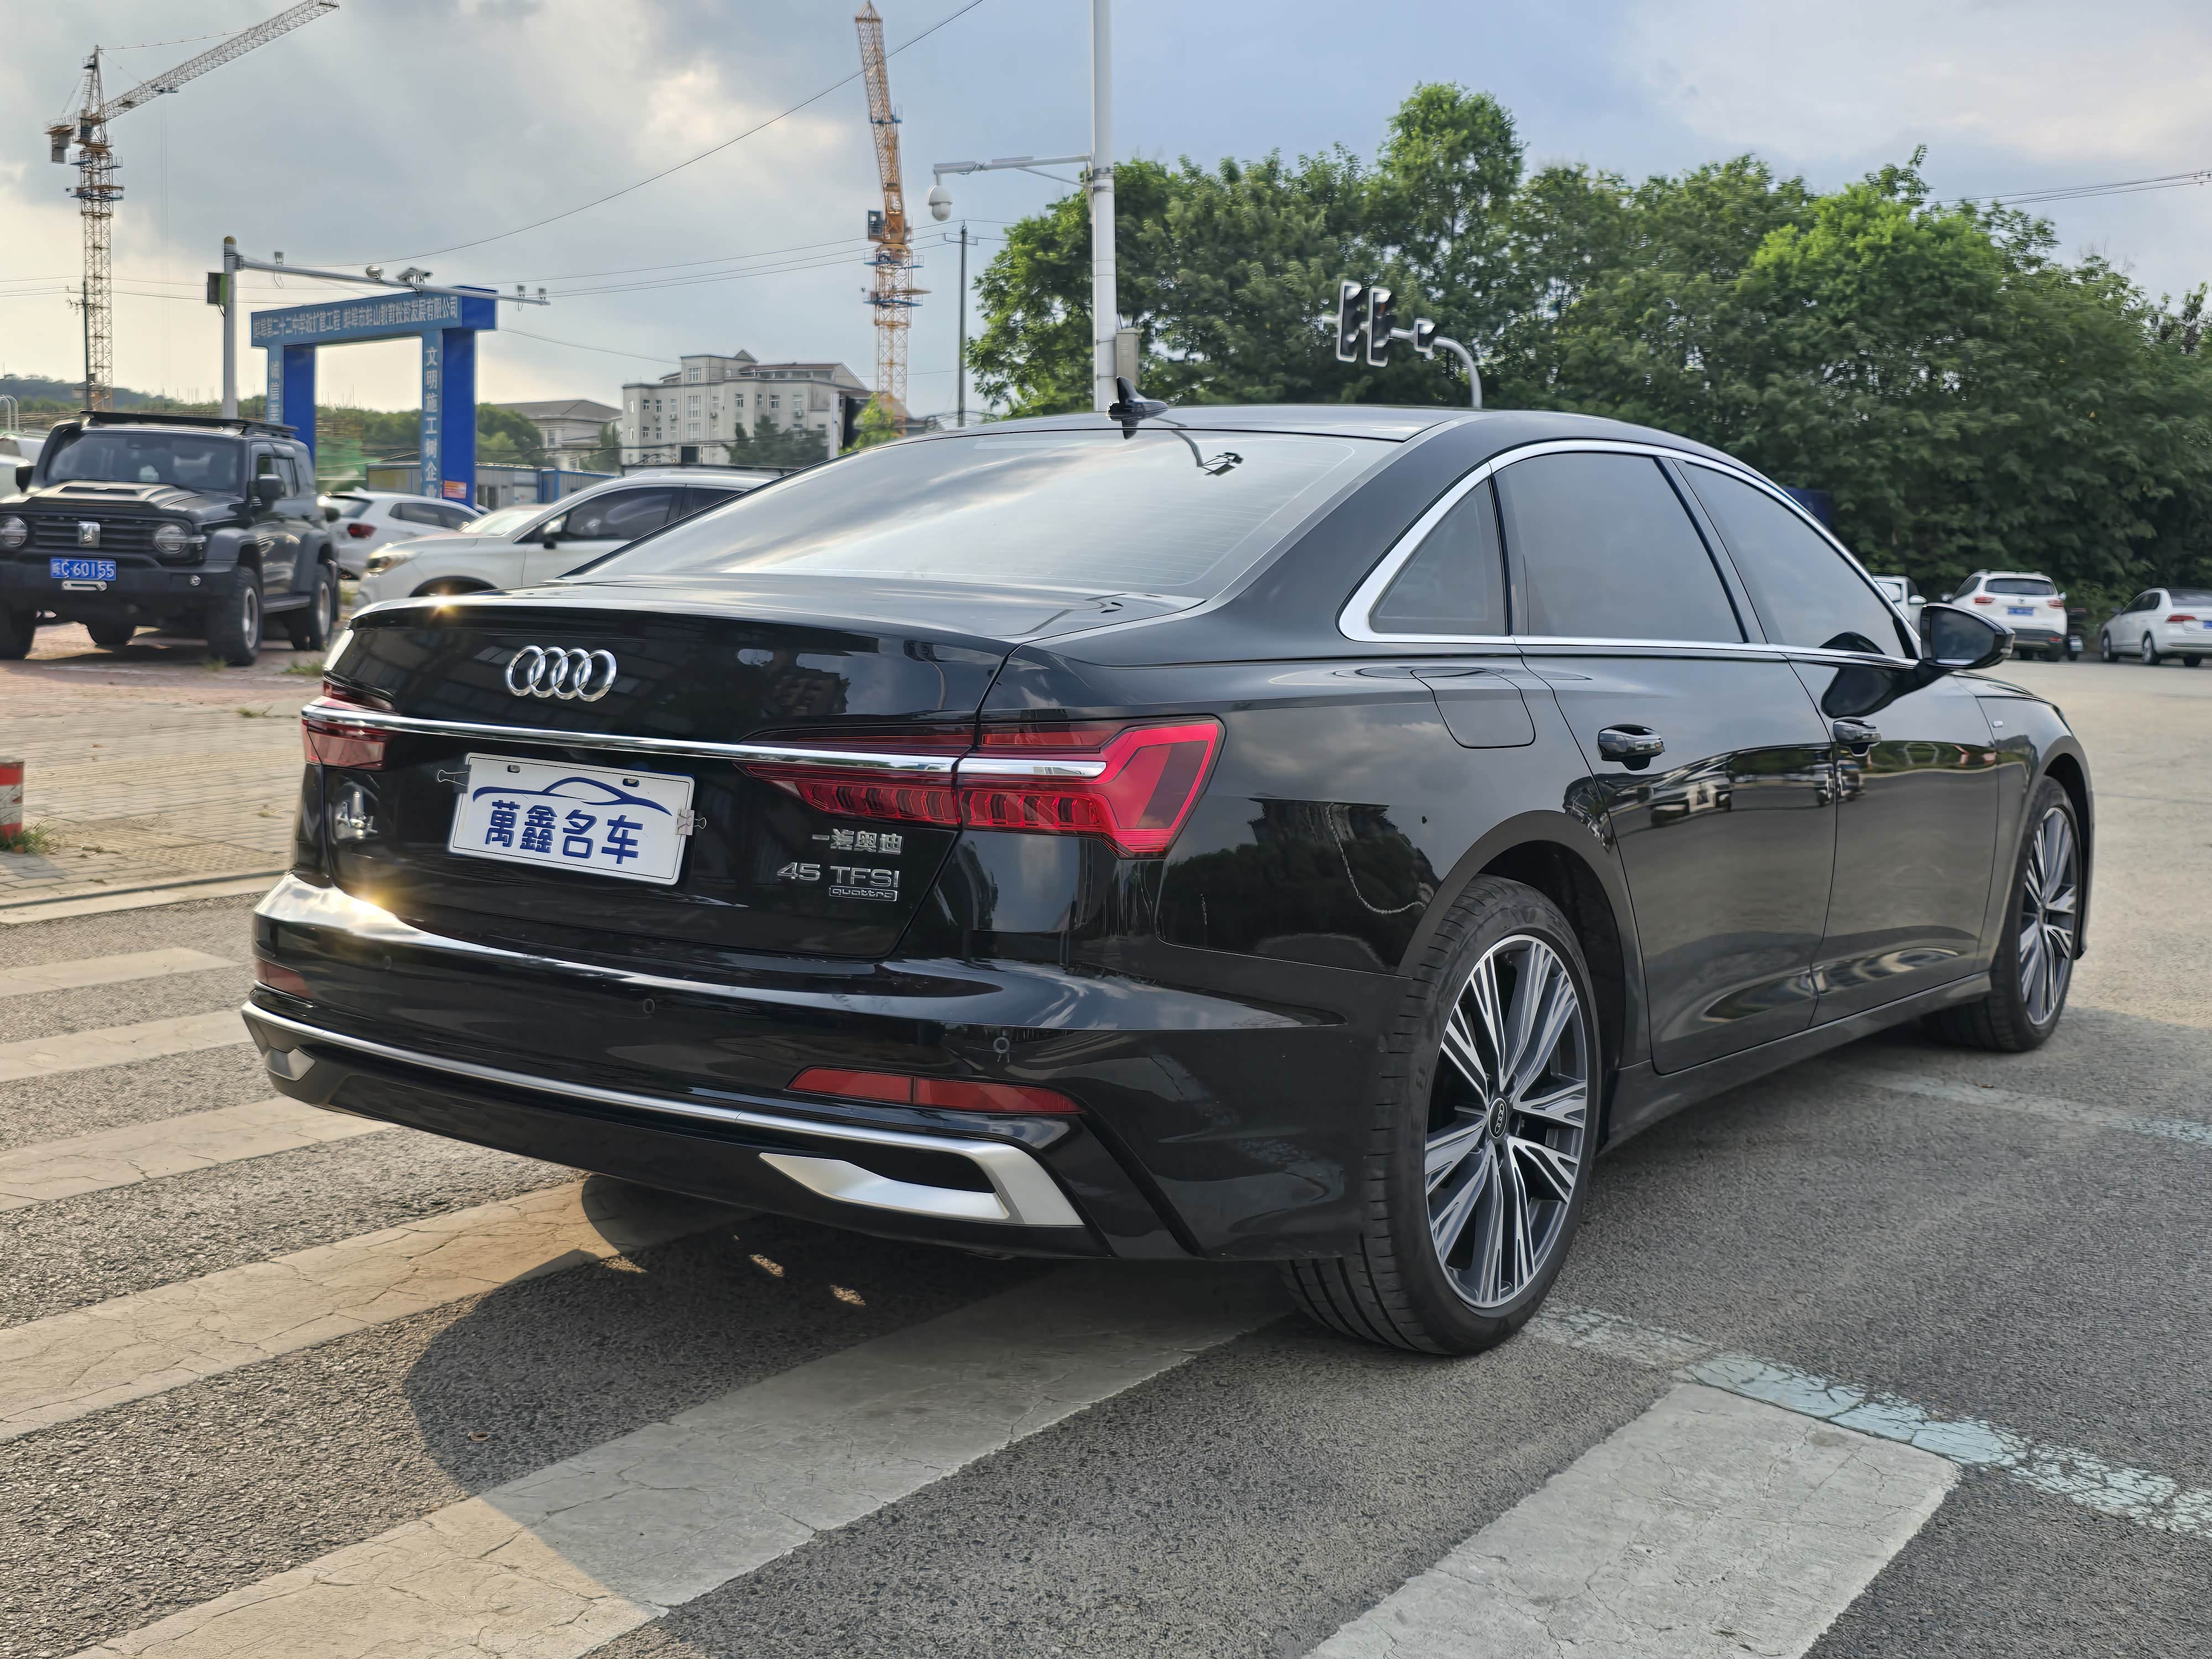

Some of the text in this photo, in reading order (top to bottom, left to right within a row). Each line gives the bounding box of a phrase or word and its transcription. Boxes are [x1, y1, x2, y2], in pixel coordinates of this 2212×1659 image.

[484, 800, 644, 864] 萬鑫名车
[812, 828, 903, 855] 一汽奥迪
[776, 862, 900, 888] 45 TFSI
[832, 888, 894, 899] quattro
